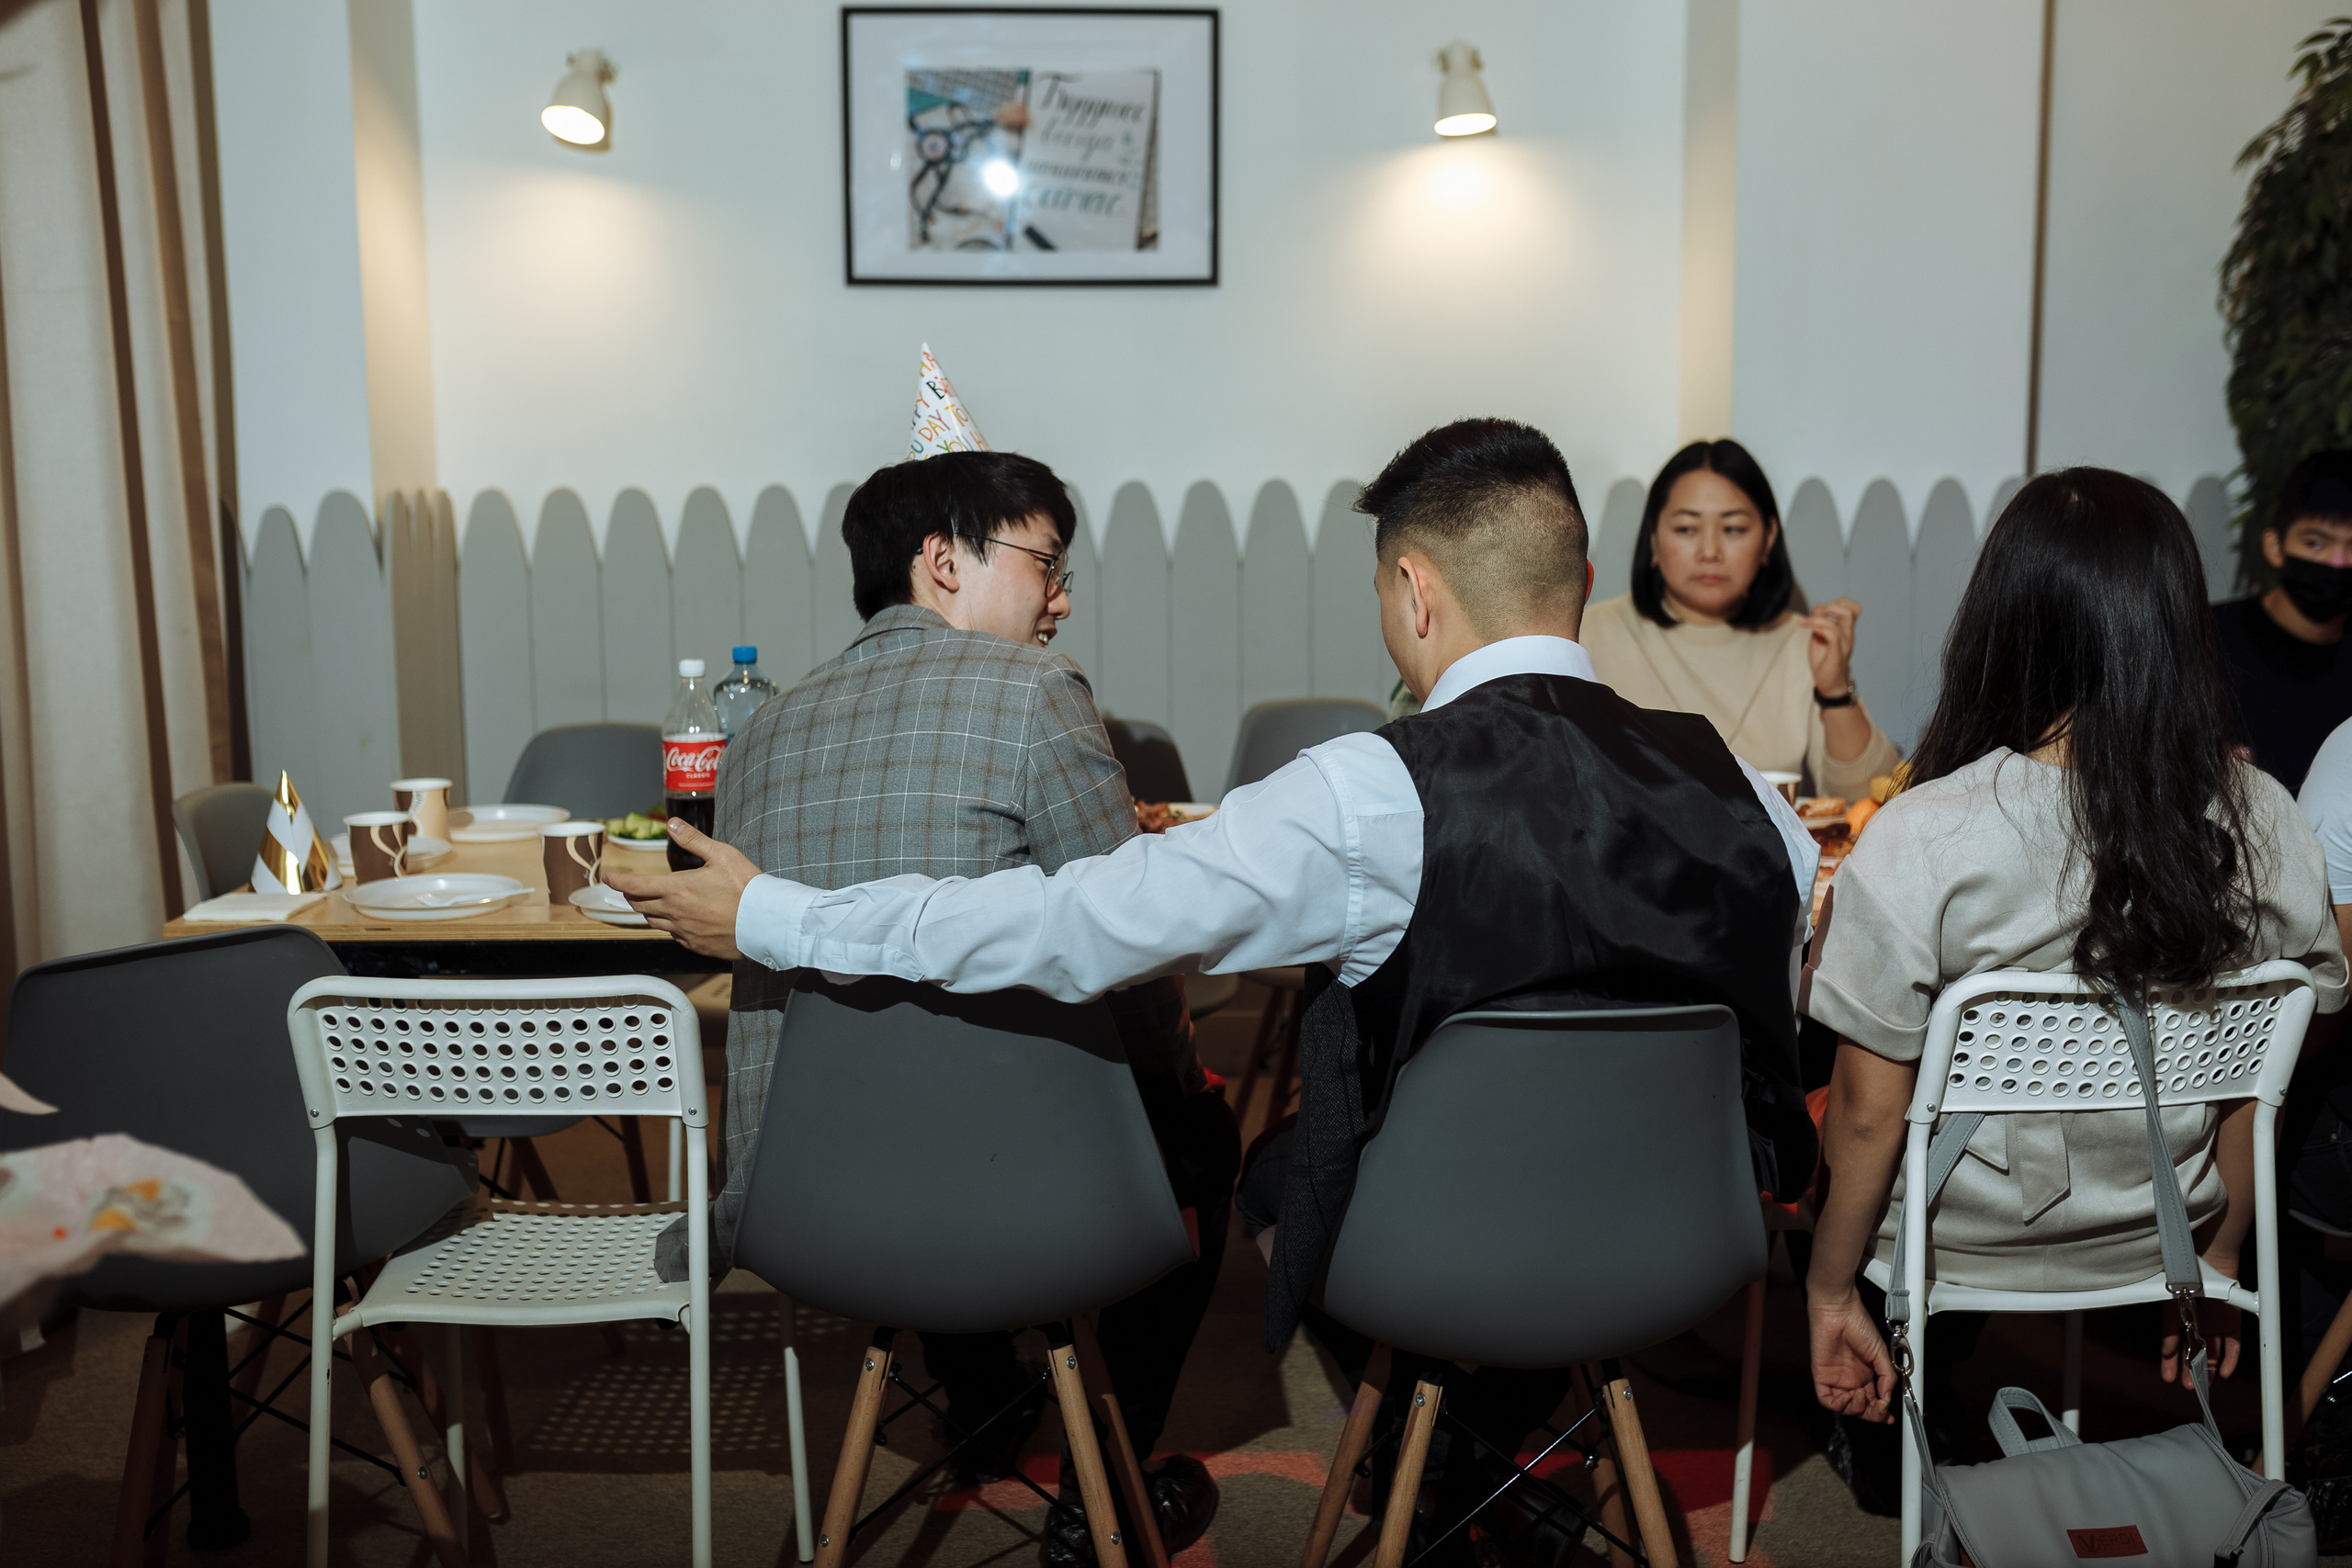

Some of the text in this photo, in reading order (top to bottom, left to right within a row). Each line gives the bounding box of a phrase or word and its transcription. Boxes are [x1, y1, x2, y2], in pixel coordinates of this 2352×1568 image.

[918, 410, 951, 442] DAY
[666, 745, 724, 773] Coca-Col
[2076, 1532, 2135, 1553] VERDI
